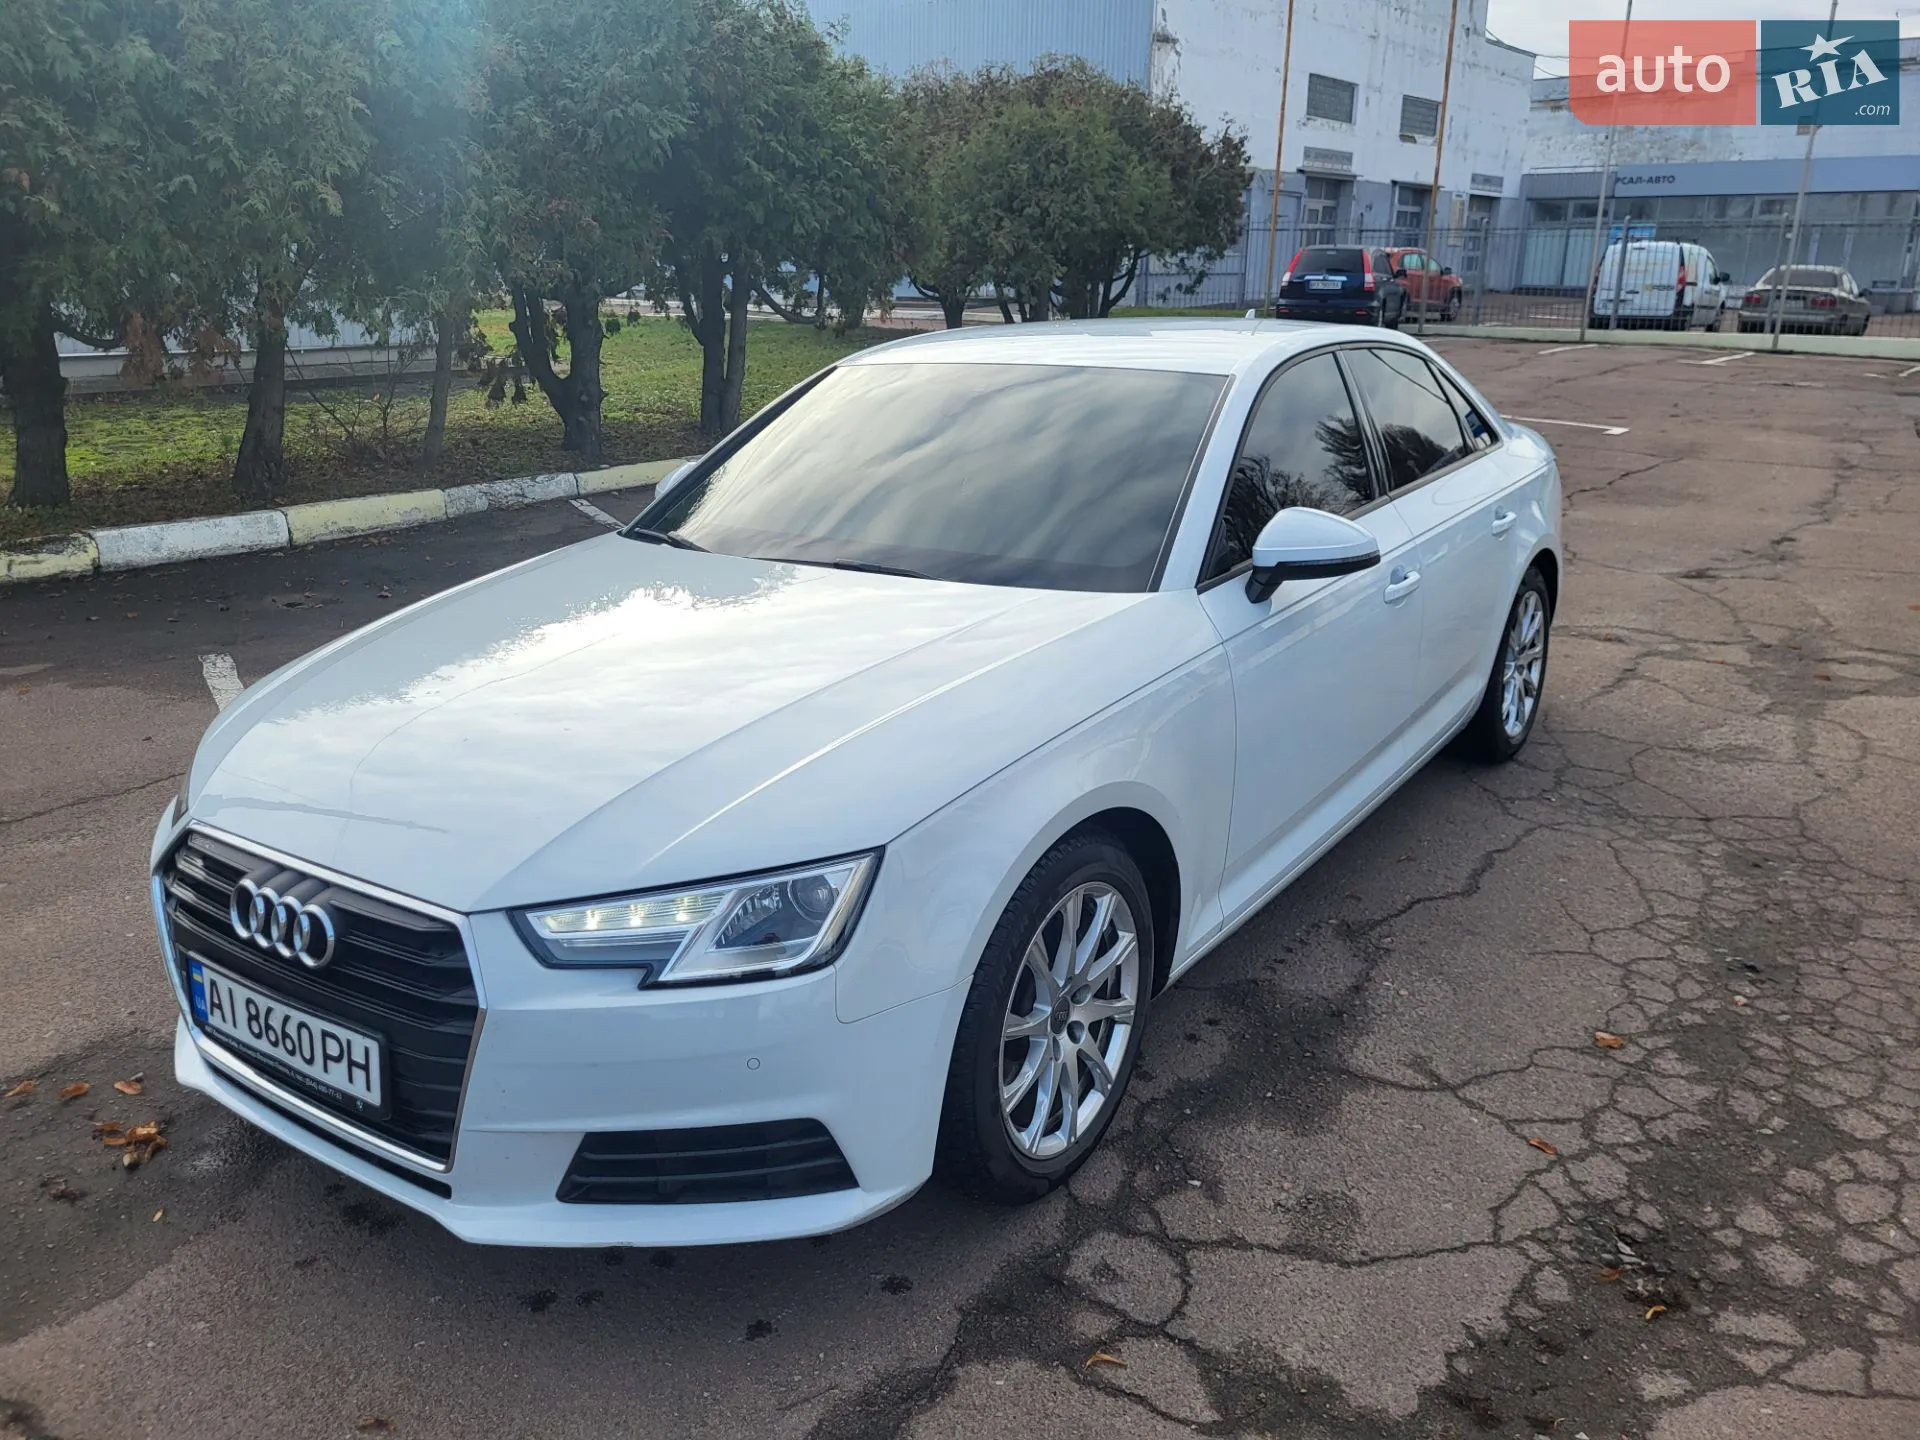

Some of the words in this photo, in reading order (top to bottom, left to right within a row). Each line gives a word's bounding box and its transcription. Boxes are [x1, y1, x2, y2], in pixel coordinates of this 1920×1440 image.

[209, 978, 237, 1029] AI
[245, 996, 315, 1066] 8660
[320, 1028, 371, 1093] PH
